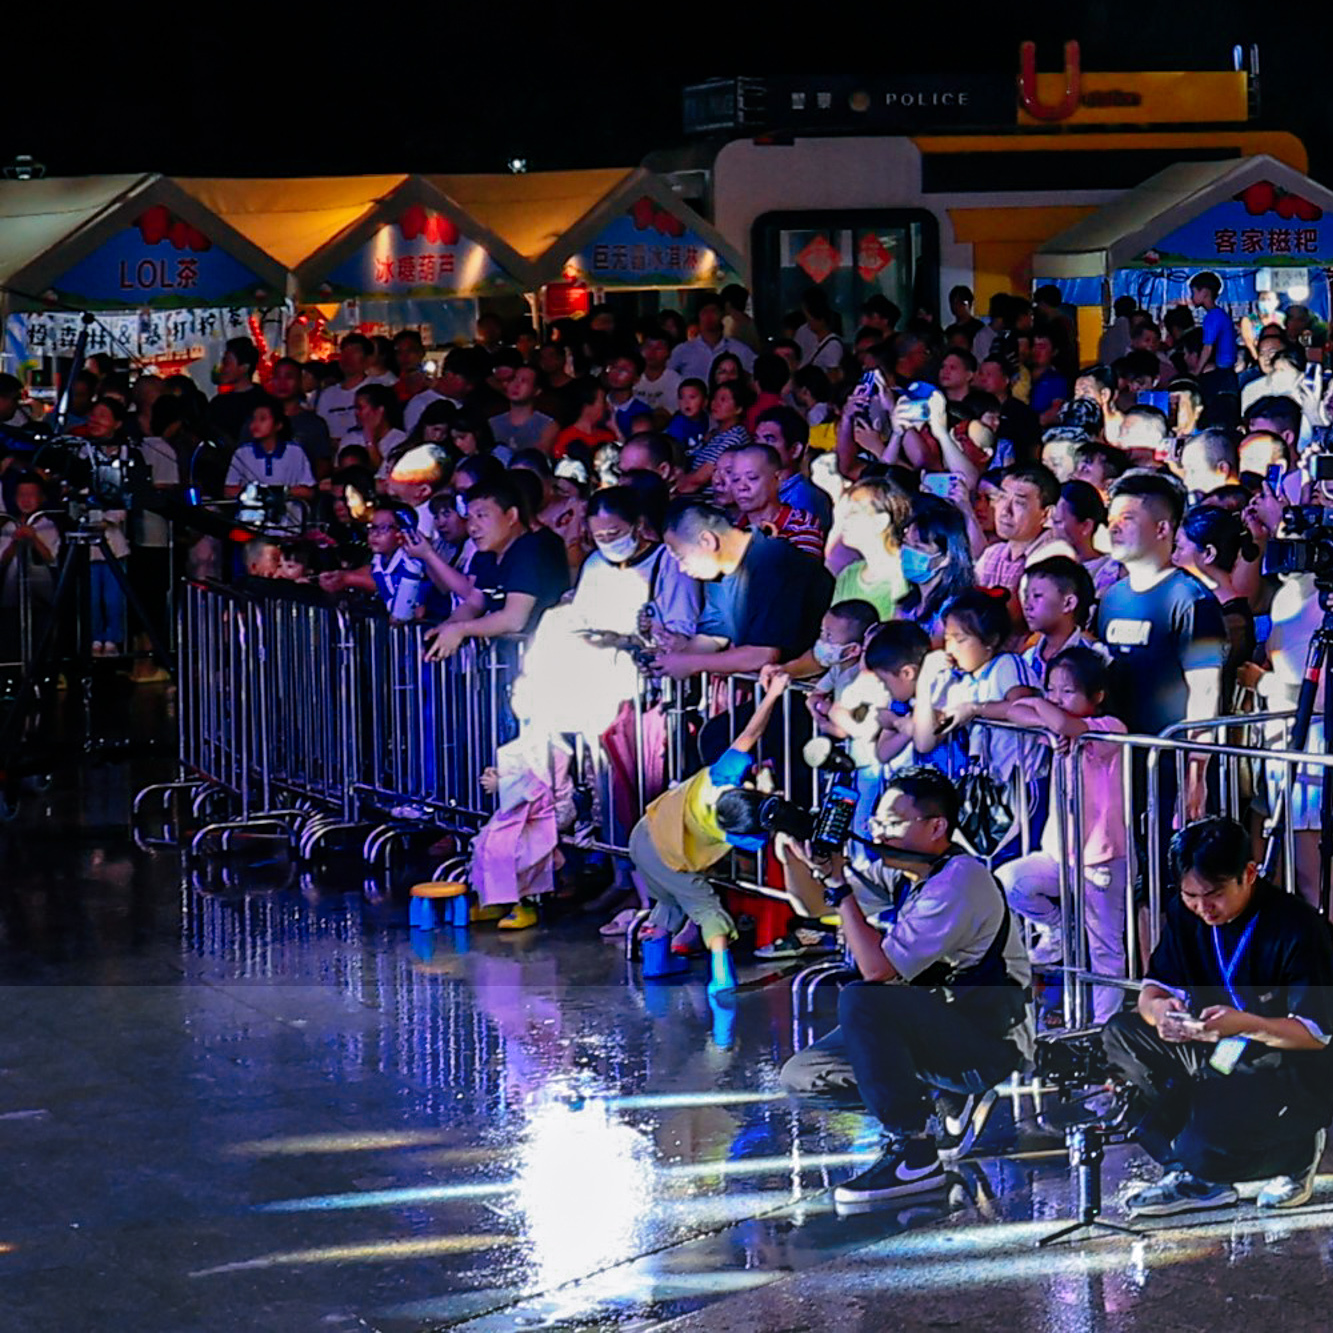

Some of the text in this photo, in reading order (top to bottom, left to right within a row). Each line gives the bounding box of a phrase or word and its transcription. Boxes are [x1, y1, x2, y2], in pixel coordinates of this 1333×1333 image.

[885, 92, 969, 107] POLICE
[1214, 227, 1319, 254] 客家糍粑
[119, 258, 199, 289] LOL茶
[375, 253, 456, 284] 冰糖葫芦
